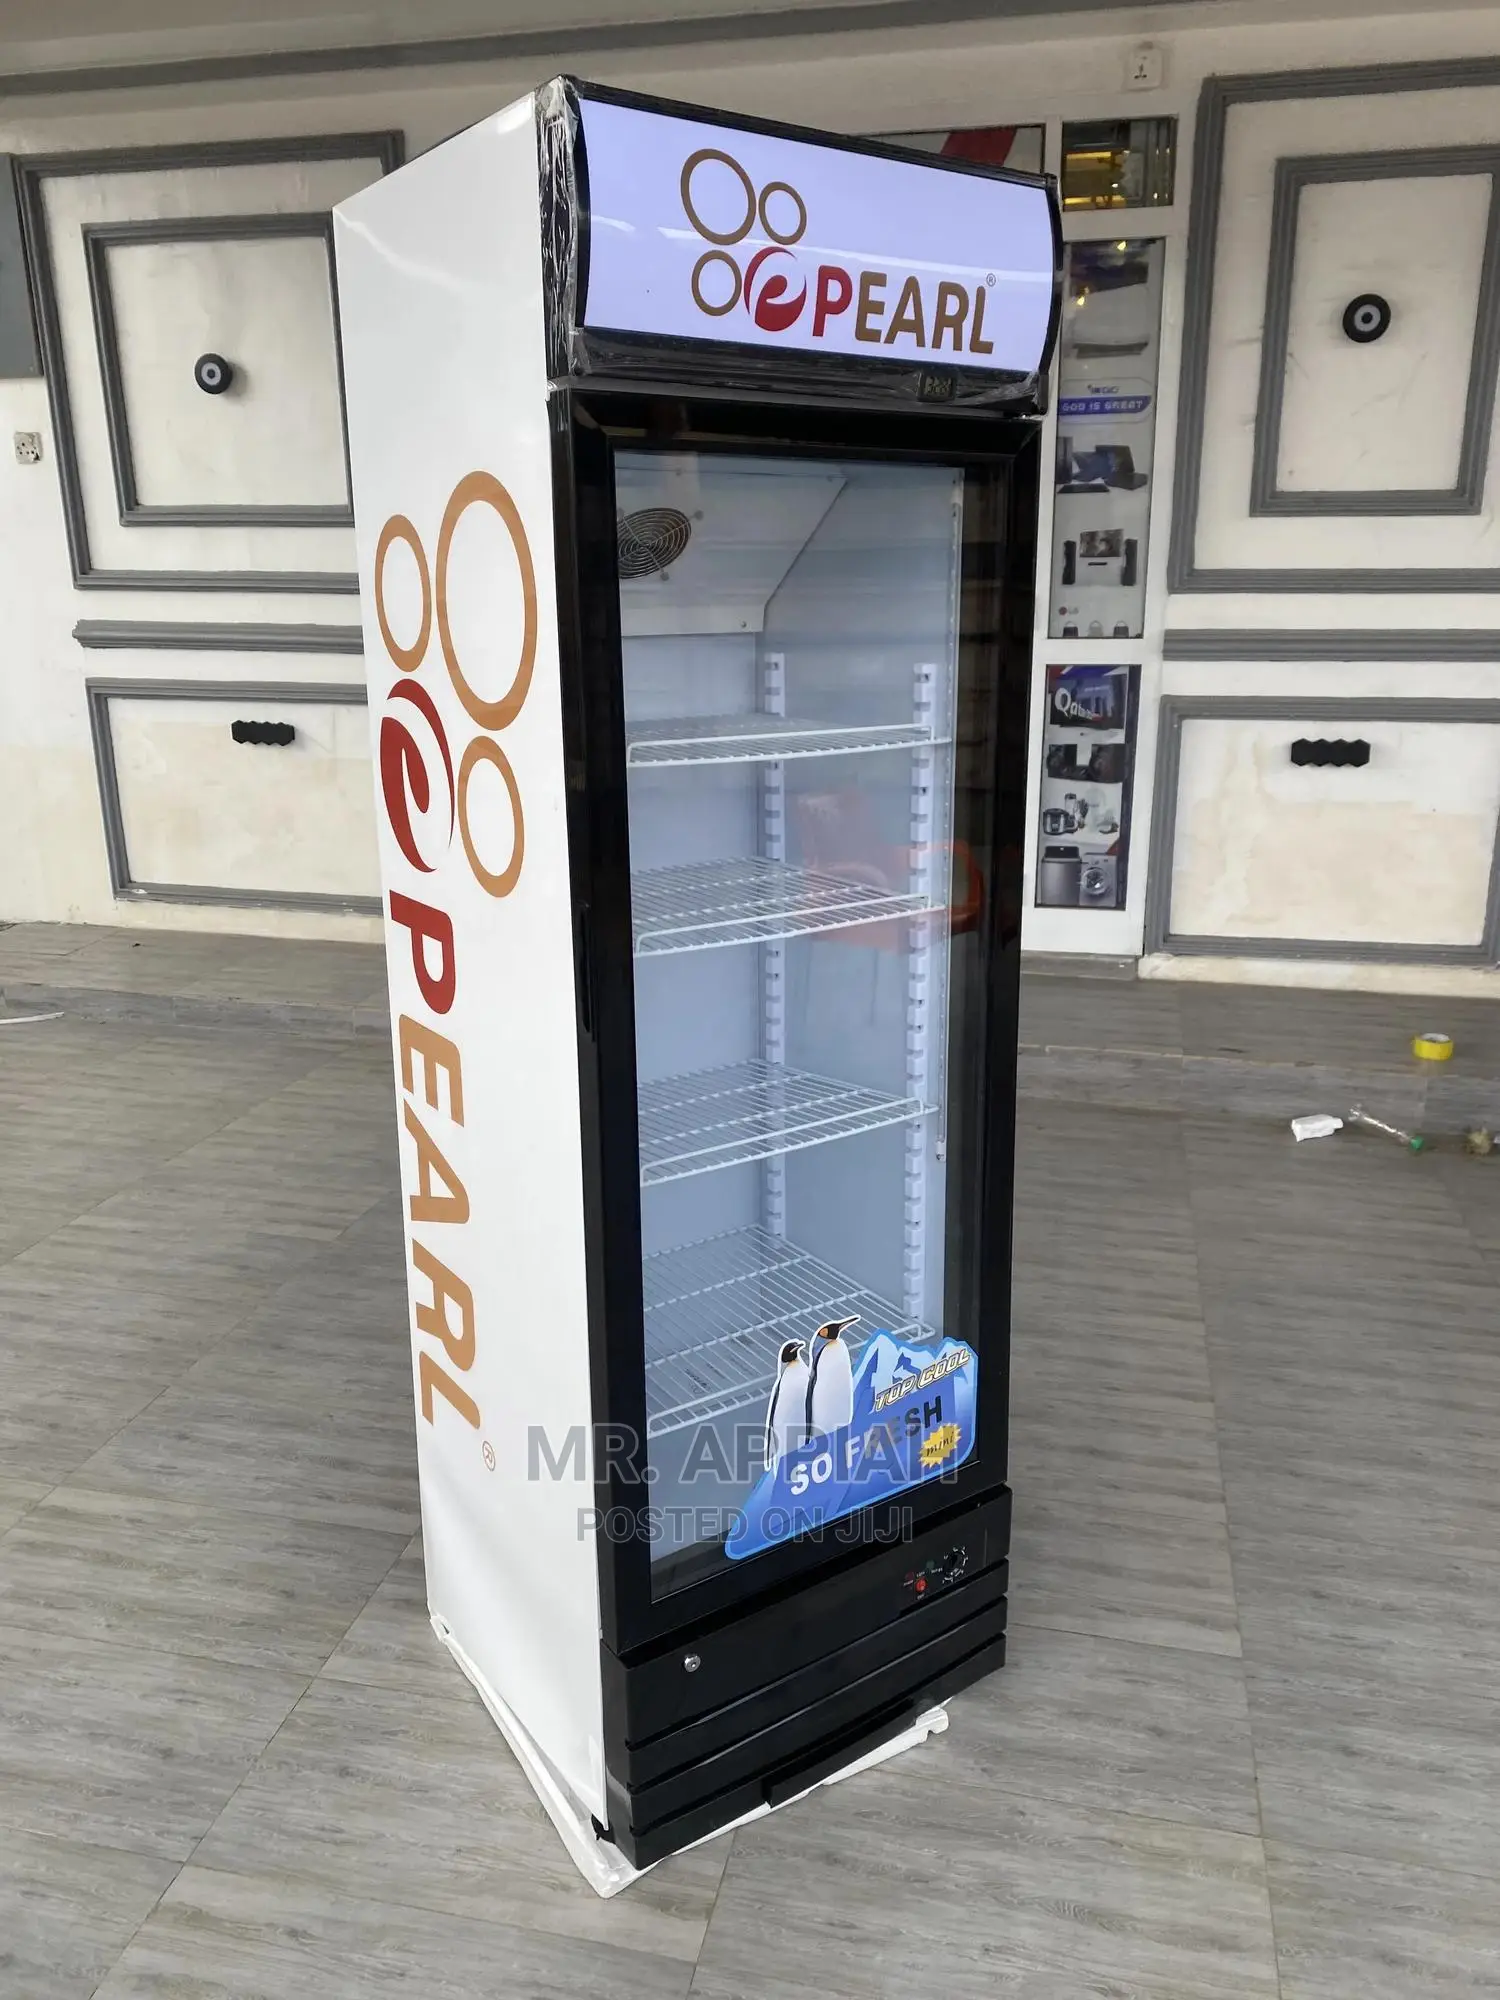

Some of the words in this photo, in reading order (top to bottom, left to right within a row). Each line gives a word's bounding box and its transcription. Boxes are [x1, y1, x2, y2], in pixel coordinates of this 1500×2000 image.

[812, 265, 994, 354] PEARL
[389, 889, 481, 1430] PEARL
[875, 1373, 917, 1412] TOP
[918, 1348, 970, 1388] COOL
[790, 1453, 832, 1495] SO
